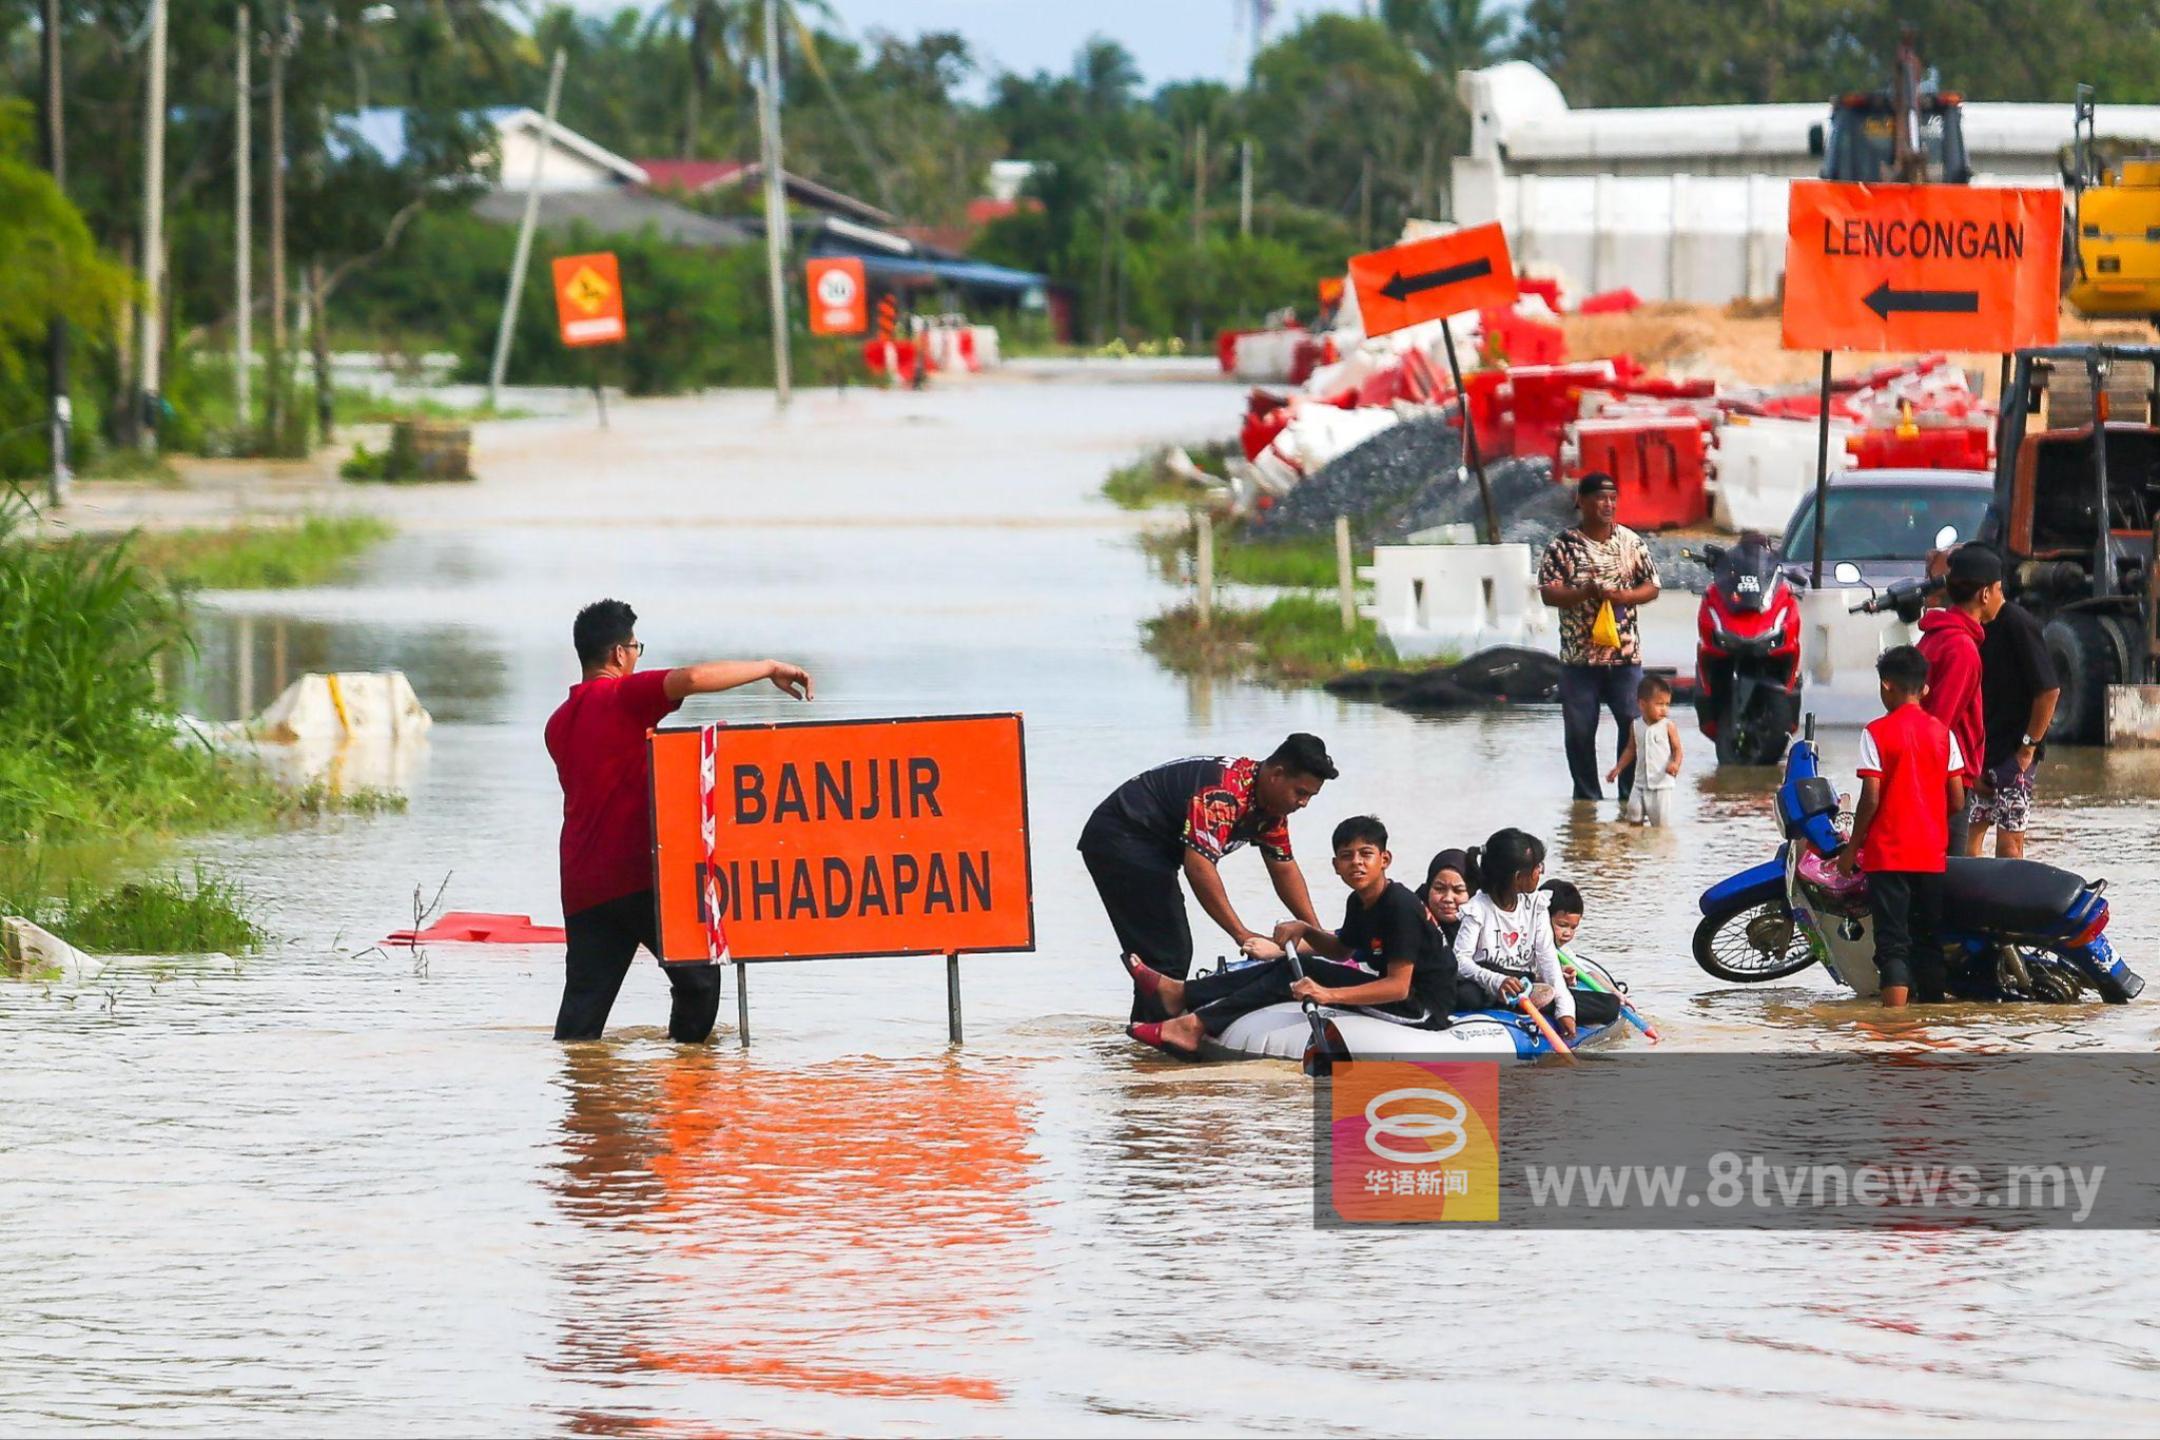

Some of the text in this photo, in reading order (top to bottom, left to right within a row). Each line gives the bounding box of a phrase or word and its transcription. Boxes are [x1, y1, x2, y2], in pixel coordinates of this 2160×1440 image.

[1823, 217, 2024, 260] LENCONGAN
[733, 757, 943, 825] BANJIR
[694, 850, 993, 924] DIHADAPAN
